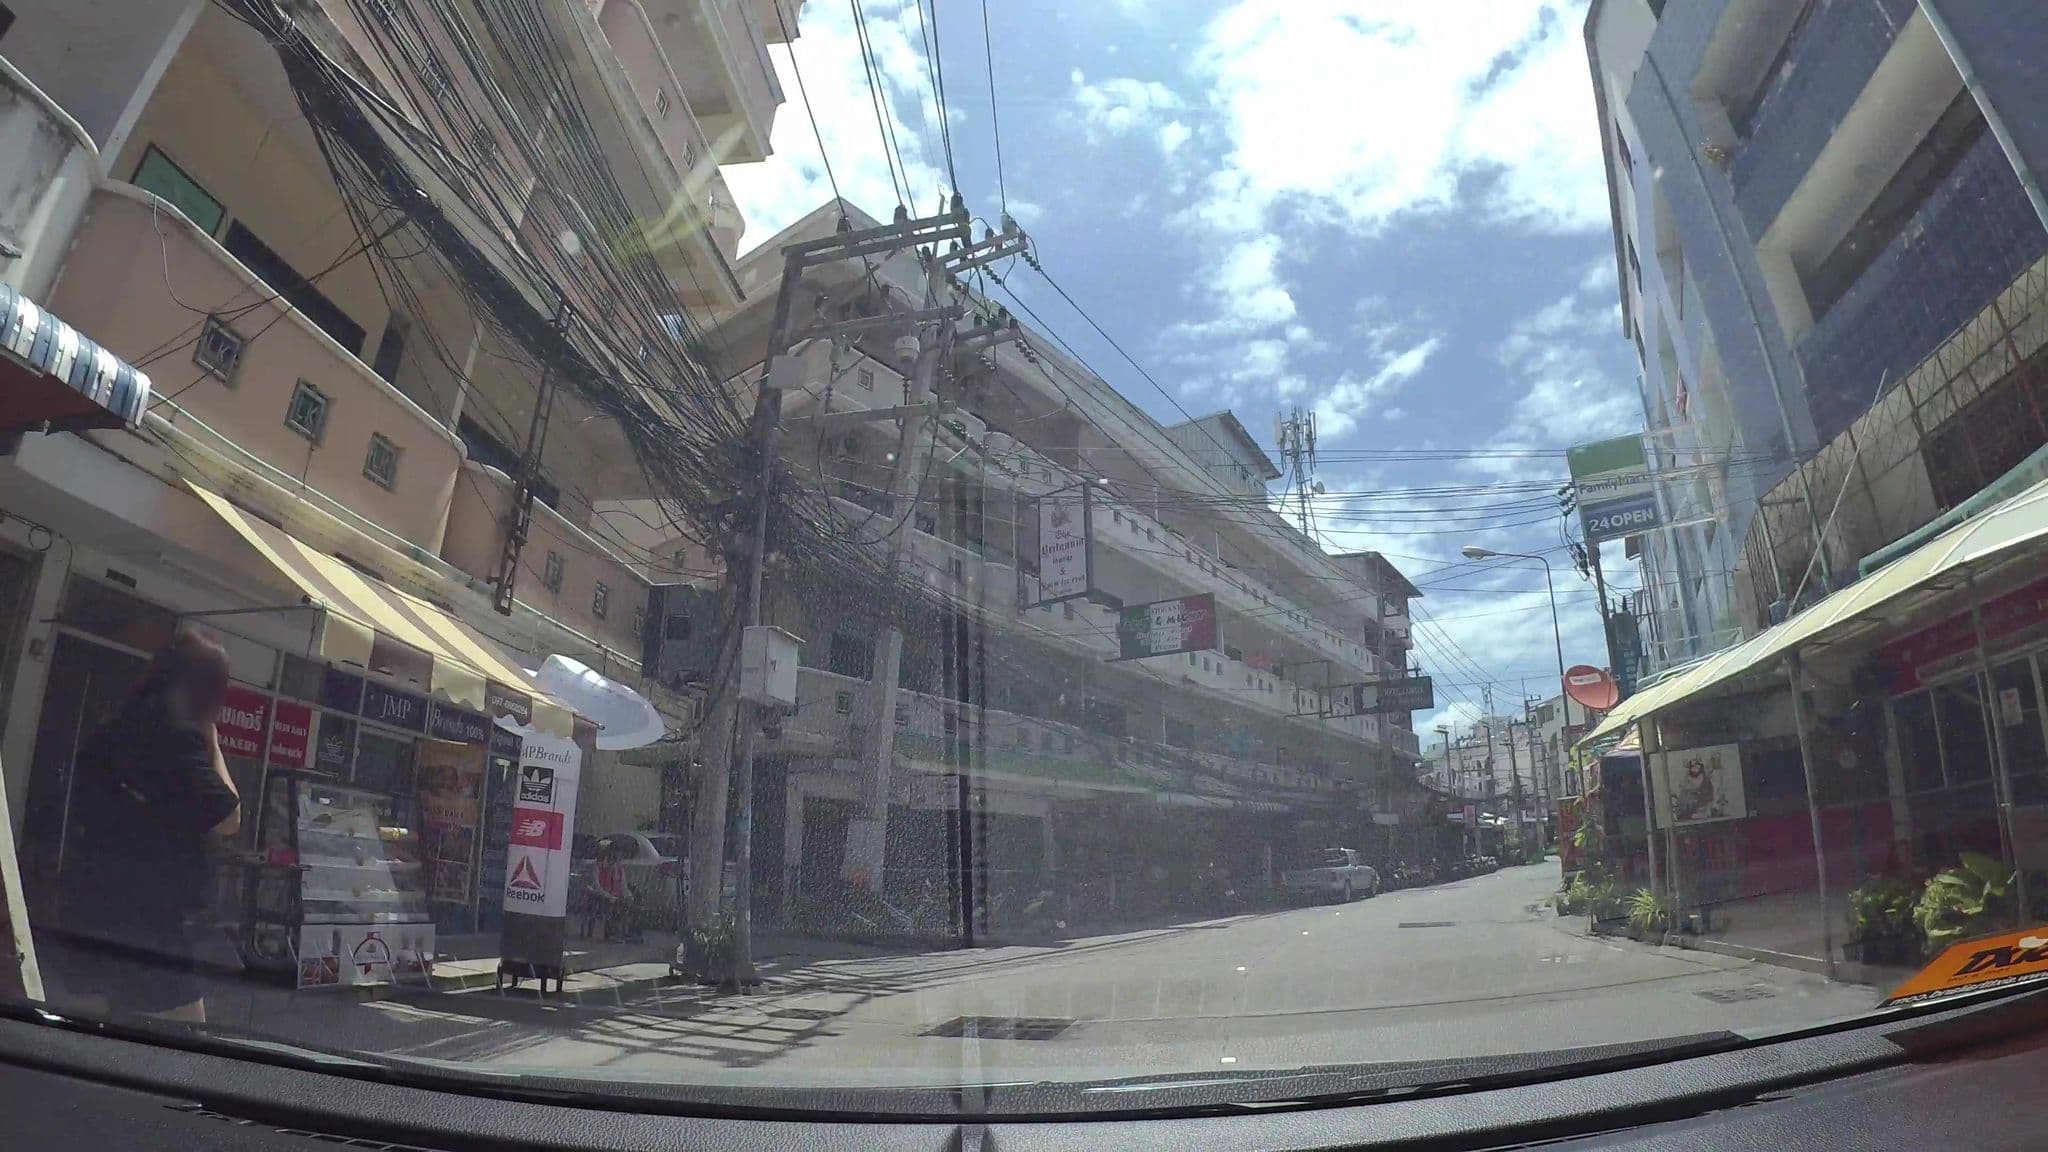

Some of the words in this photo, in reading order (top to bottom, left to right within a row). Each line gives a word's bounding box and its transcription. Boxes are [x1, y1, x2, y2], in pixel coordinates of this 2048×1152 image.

[380, 693, 411, 719] JMP
[431, 708, 464, 735] Brands
[466, 725, 484, 741] 100%
[520, 791, 550, 803] adidas
[506, 887, 545, 903] Reebok
